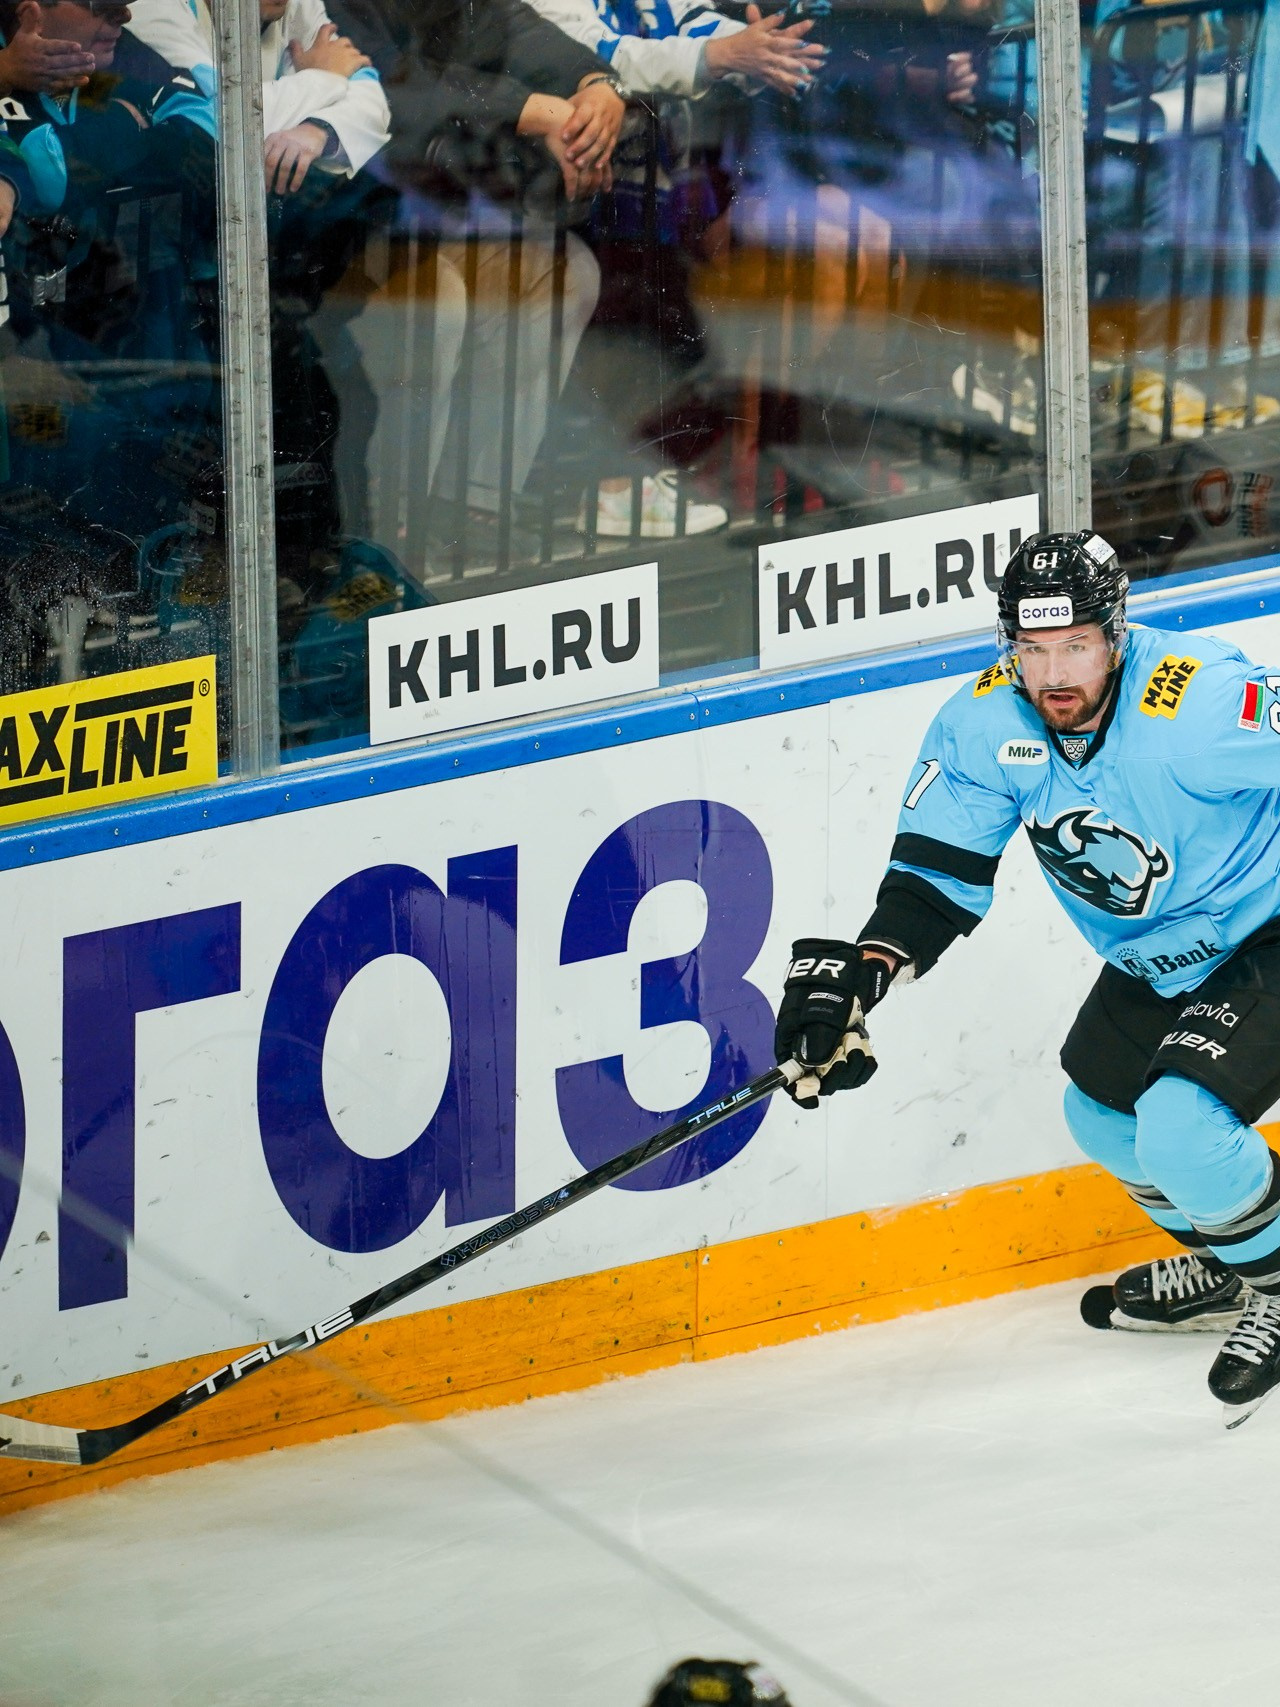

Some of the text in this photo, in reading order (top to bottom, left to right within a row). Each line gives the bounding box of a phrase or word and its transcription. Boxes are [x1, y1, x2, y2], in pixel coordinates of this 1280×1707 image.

[778, 528, 1021, 634] KHL.RU
[1032, 552, 1059, 570] 61
[1022, 606, 1070, 619] согаз
[388, 598, 640, 708] KHL.RU
[1144, 662, 1176, 708] MAX
[1161, 661, 1196, 710] LINE
[68, 706, 193, 794] LINE
[1008, 746, 1044, 759] МИР
[1147, 939, 1227, 975] Bank
[1178, 1001, 1240, 1028] elavia
[0, 800, 775, 1312] газ
[688, 1087, 753, 1124] TRUE
[185, 1306, 354, 1395] TRUE
